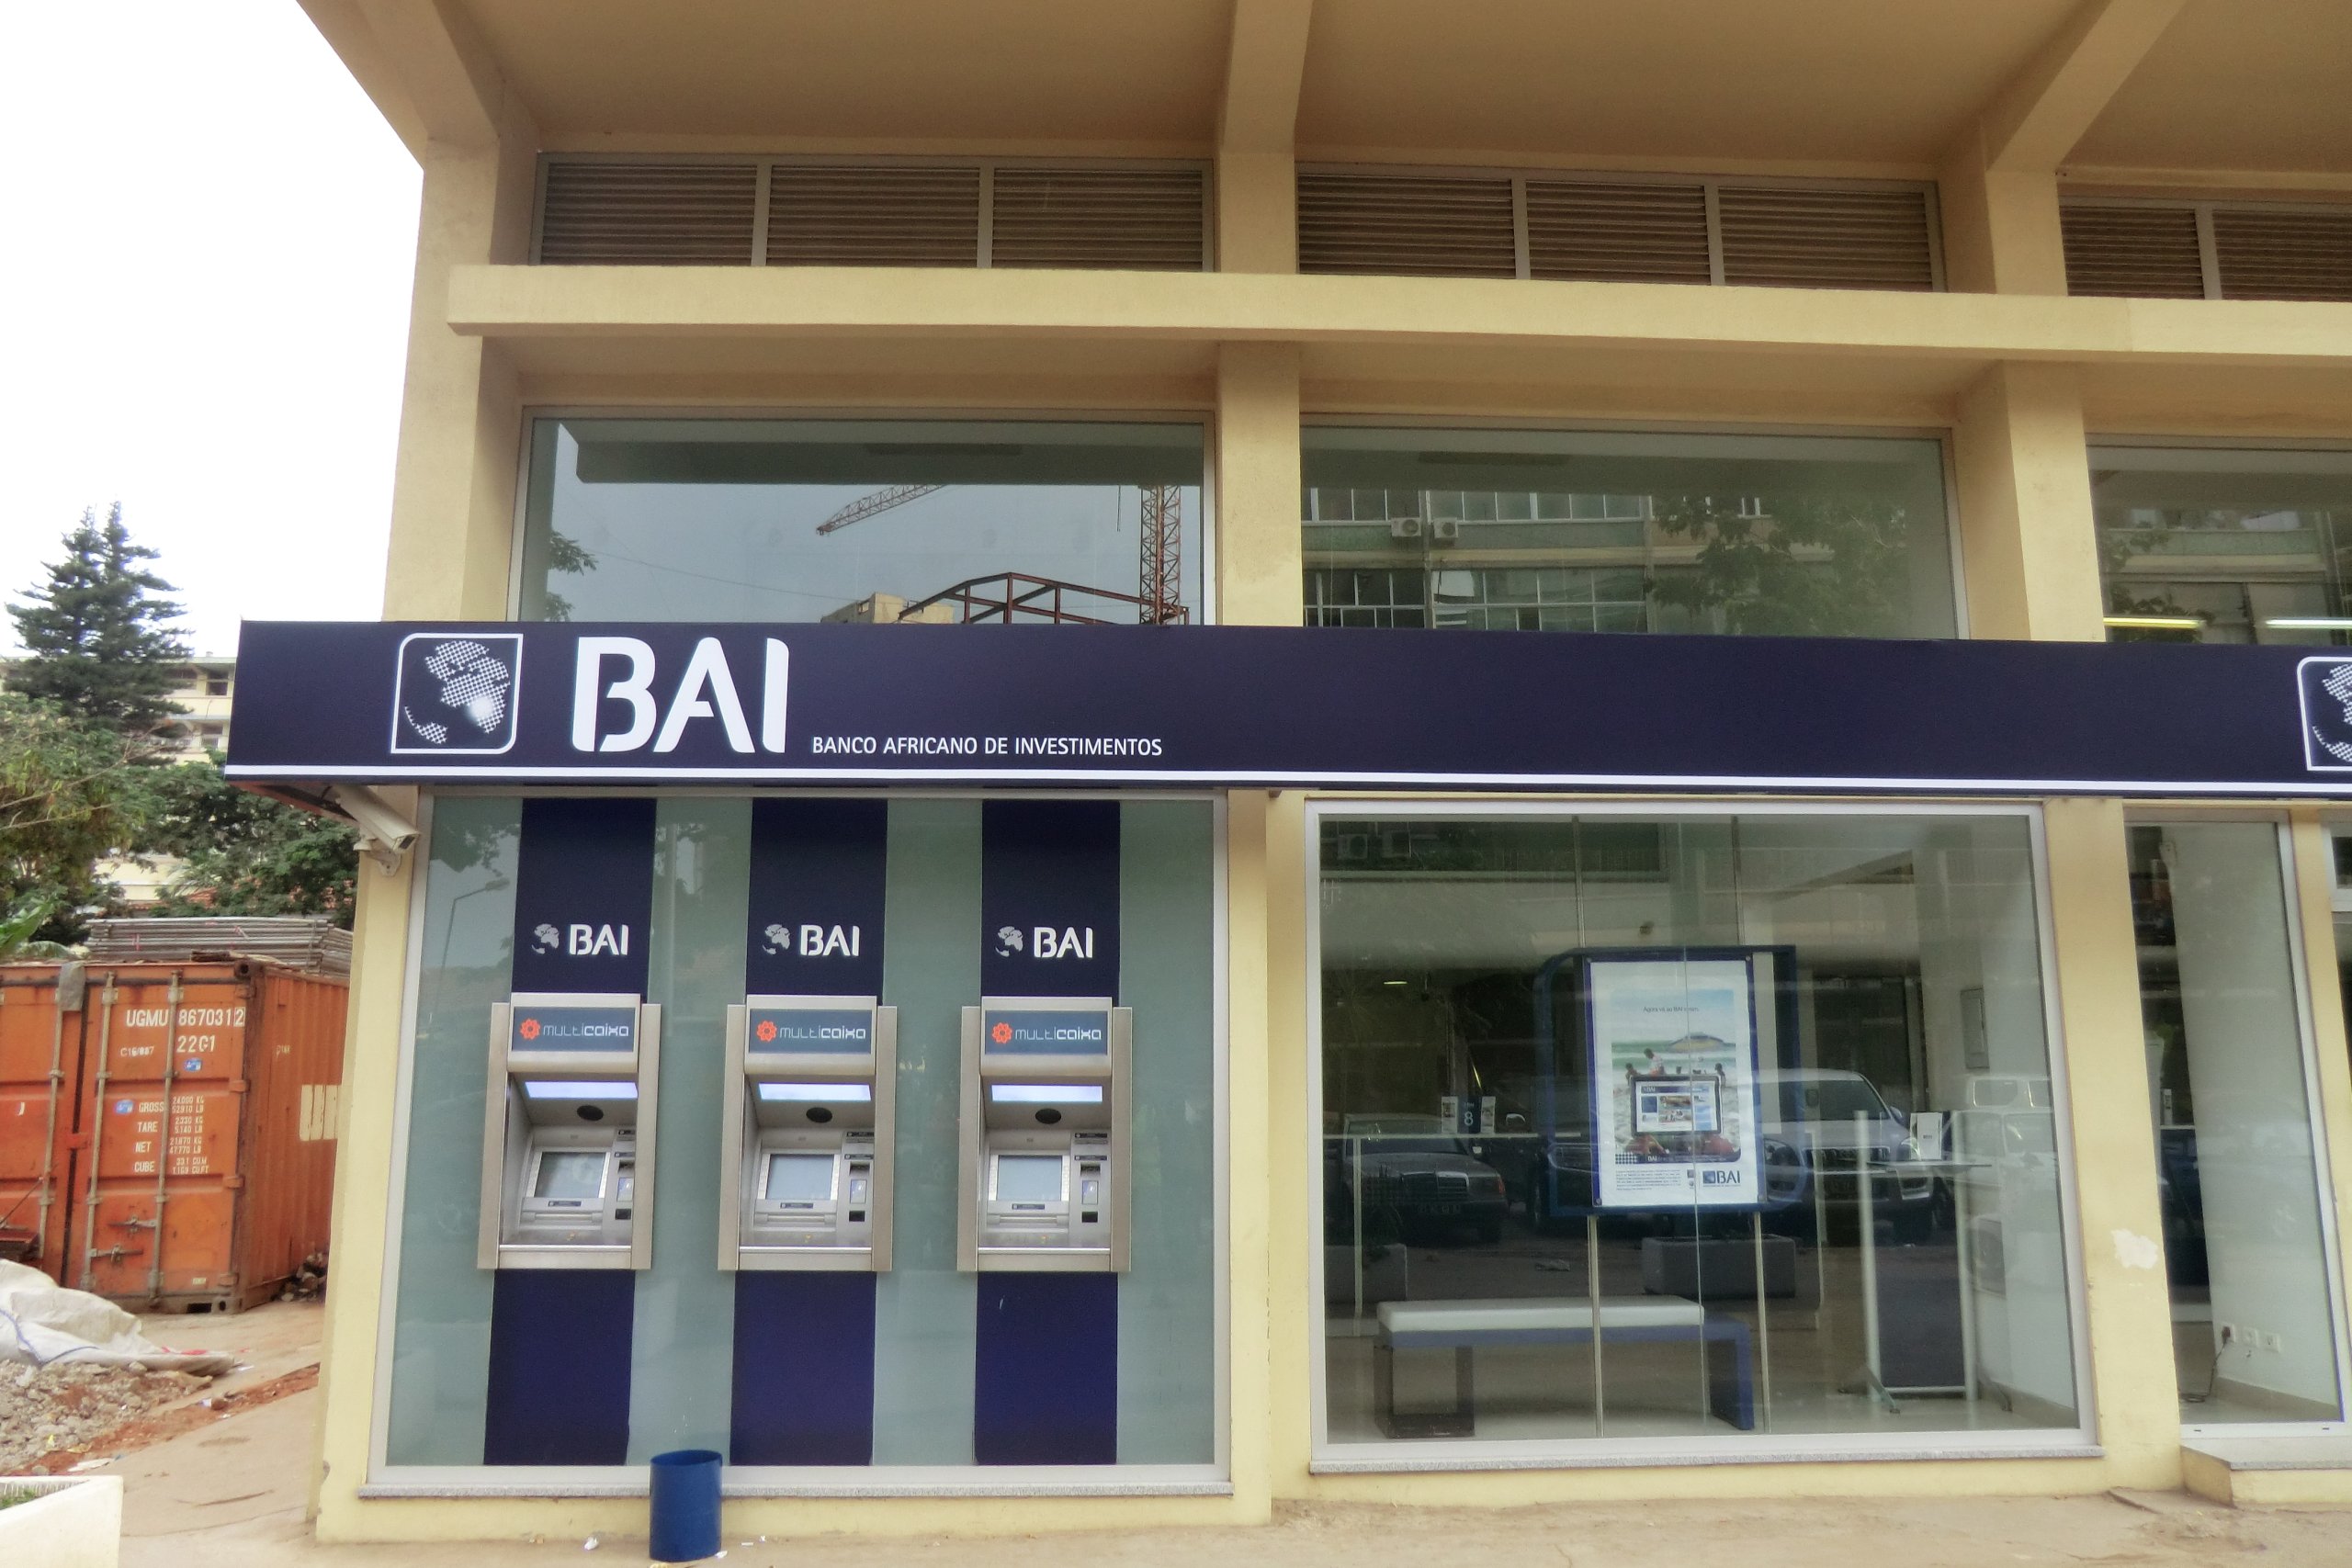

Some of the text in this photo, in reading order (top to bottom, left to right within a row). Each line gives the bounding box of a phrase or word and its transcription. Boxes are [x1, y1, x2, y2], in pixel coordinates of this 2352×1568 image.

[572, 637, 789, 753] BAI
[812, 737, 1162, 756] BANCO AFRICANO DE INVESTIMENTOS
[569, 924, 629, 955] BAI
[800, 925, 860, 956] BAI
[1034, 927, 1093, 958] BAI
[126, 1007, 245, 1027] UGMU 8670312
[543, 1022, 629, 1037] multicaixa
[779, 1025, 866, 1039] multicaixa
[1015, 1026, 1102, 1040] multicaixa
[176, 1034, 216, 1053] 22G1
[139, 1101, 164, 1113] GROSS
[137, 1122, 158, 1133] TARE
[135, 1141, 152, 1153] NET
[134, 1161, 155, 1173] CUBE
[1716, 1169, 1741, 1184] BAI
